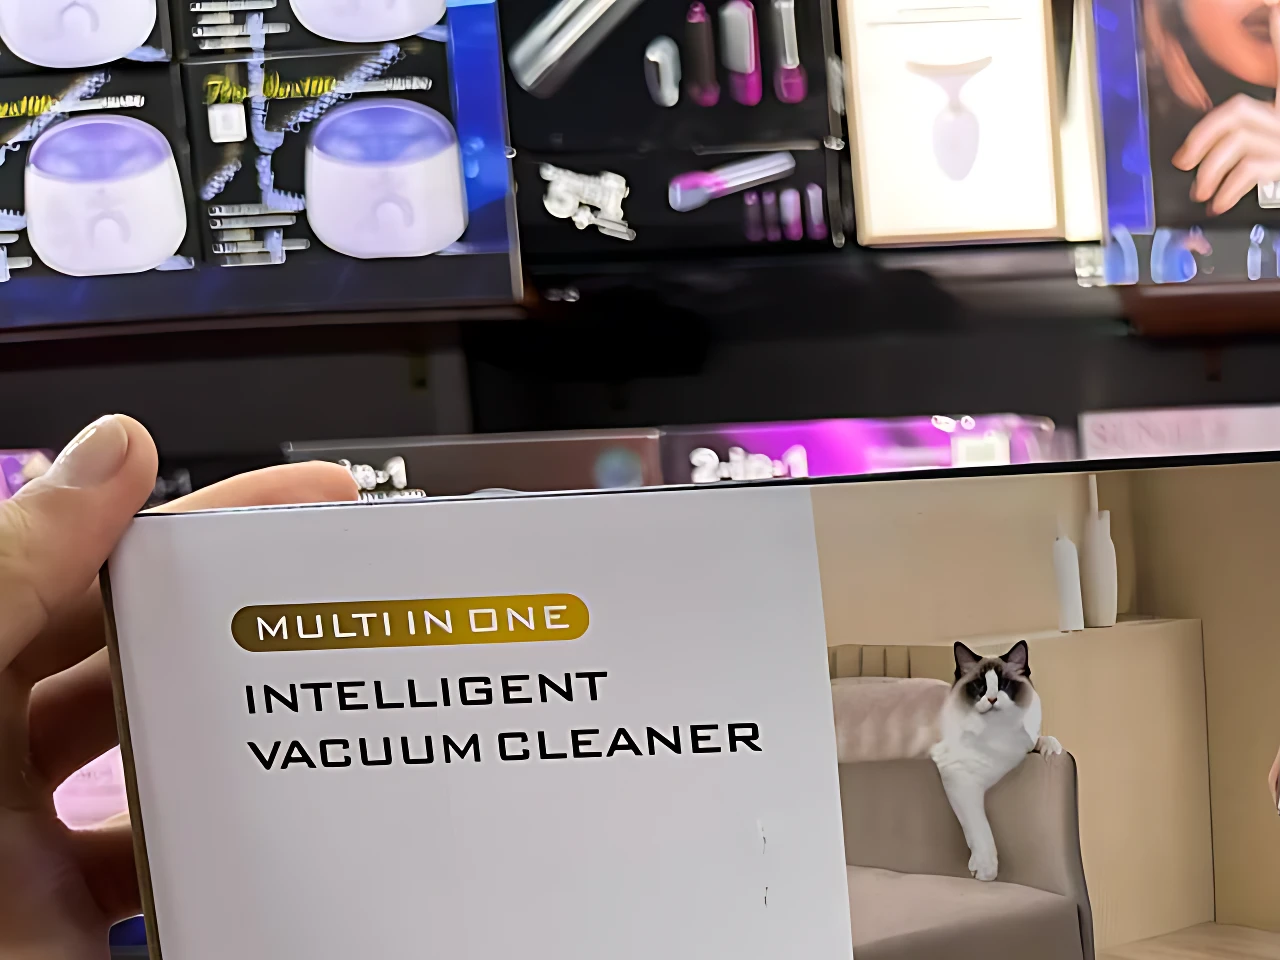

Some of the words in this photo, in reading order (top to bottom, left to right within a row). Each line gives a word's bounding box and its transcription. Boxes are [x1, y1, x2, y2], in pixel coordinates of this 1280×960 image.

[256, 611, 391, 641] MULTI
[407, 609, 453, 636] IN
[468, 605, 570, 633] ONE
[245, 671, 608, 715] INTELLIGENT
[246, 733, 482, 771] VACUUM
[497, 722, 763, 761] CLEANER
